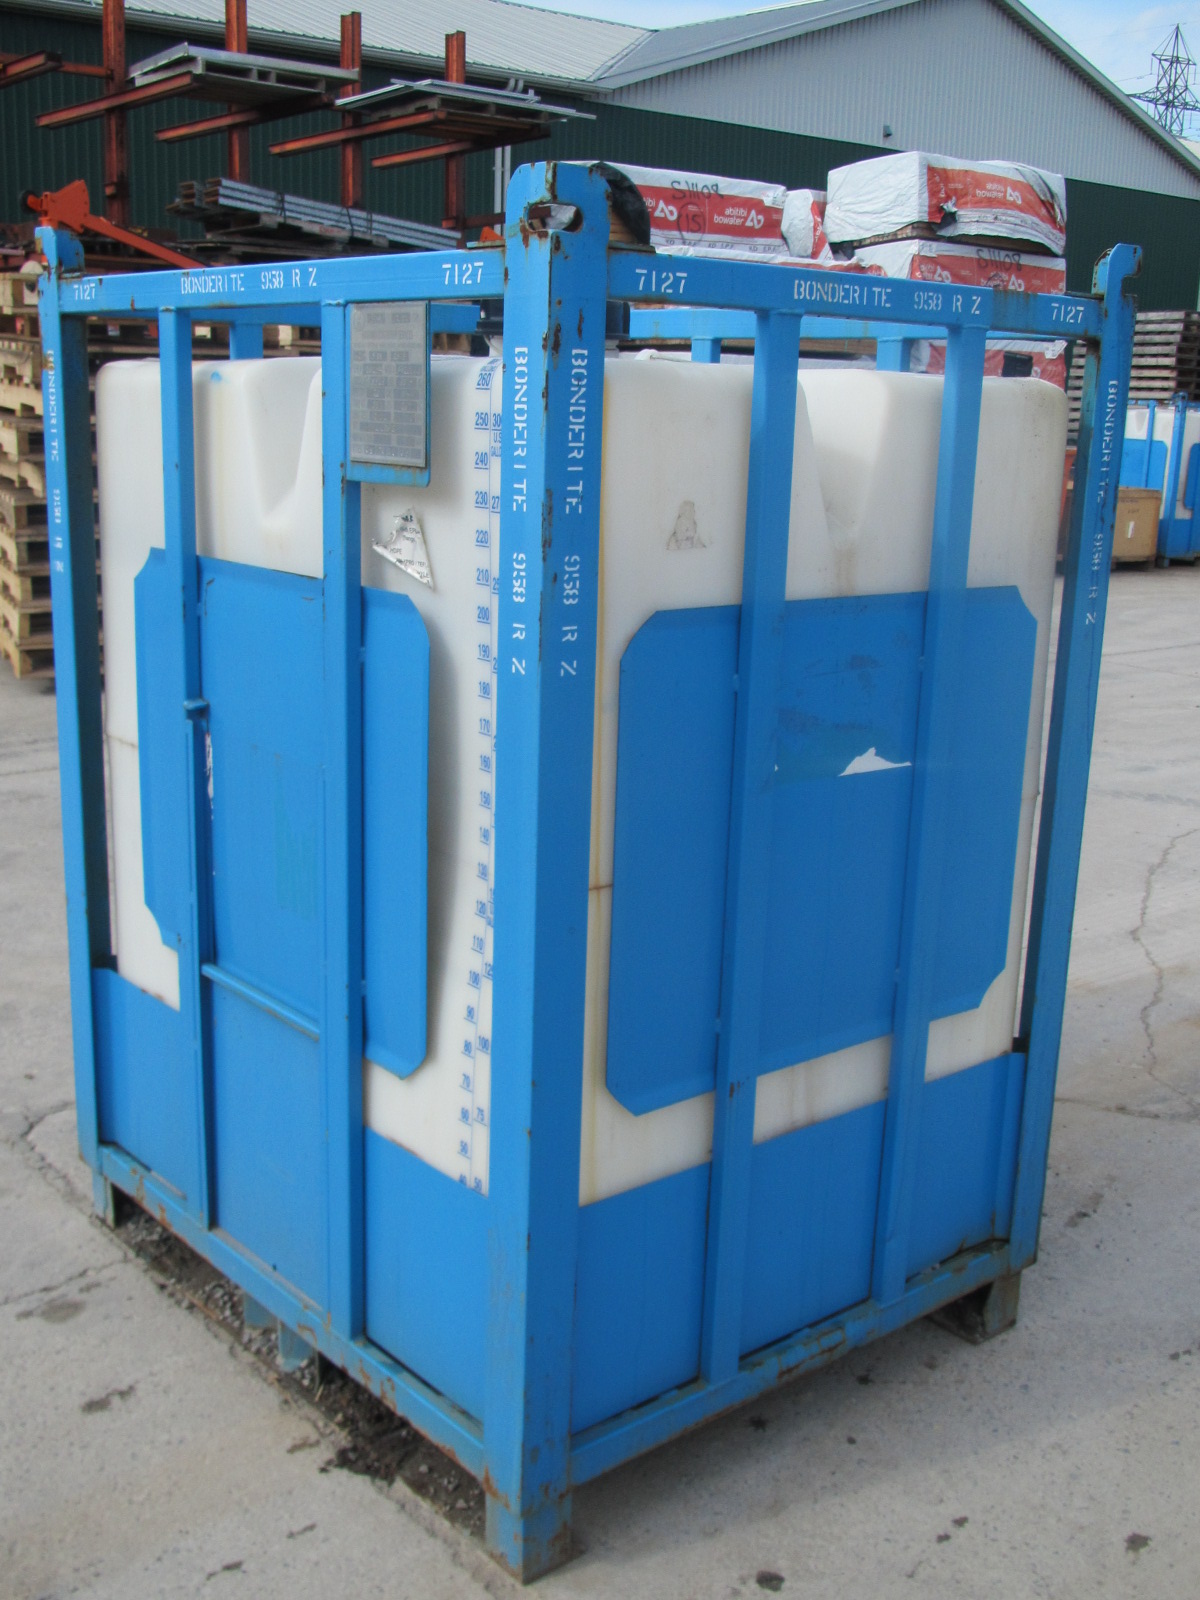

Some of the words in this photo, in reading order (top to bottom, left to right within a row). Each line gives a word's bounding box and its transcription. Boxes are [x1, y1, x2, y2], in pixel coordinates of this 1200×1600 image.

[713, 213, 744, 226] bowater
[724, 207, 748, 217] abitibi
[180, 273, 245, 295] BONDERITE
[260, 270, 284, 290] 958
[291, 269, 301, 288] R
[308, 267, 317, 287] Z
[441, 261, 484, 286] 7127
[635, 268, 688, 294] 7127
[73, 283, 96, 301] 7127
[793, 279, 892, 308] BONDERITE
[913, 291, 942, 311] 958
[952, 294, 962, 313] R
[971, 295, 981, 315] Z
[1051, 302, 1085, 324] 7127
[475, 412, 489, 427] 250
[492, 413, 502, 428] 30
[512, 347, 529, 513] BONDERITE
[565, 348, 589, 515] BONDERITE
[474, 451, 488, 467] 240
[475, 490, 488, 506] 230
[491, 496, 500, 510] 27
[476, 530, 489, 545] 220
[476, 567, 489, 583] 210
[512, 552, 527, 603] 958
[563, 555, 581, 606] 958
[477, 605, 490, 621] 200
[511, 623, 526, 640] R
[561, 625, 578, 642] R
[478, 643, 490, 659] 190
[511, 657, 526, 676] Z
[560, 659, 577, 677] Z
[479, 680, 490, 697] 180
[479, 718, 490, 734] 170
[473, 935, 484, 952] 110
[469, 970, 480, 986] 100
[484, 962, 493, 978] 12
[464, 1039, 472, 1055] 80
[479, 1035, 490, 1051] 100
[462, 1073, 471, 1088] 70
[461, 1106, 470, 1122] 60
[477, 1107, 485, 1122] 75
[460, 1140, 469, 1155] 50
